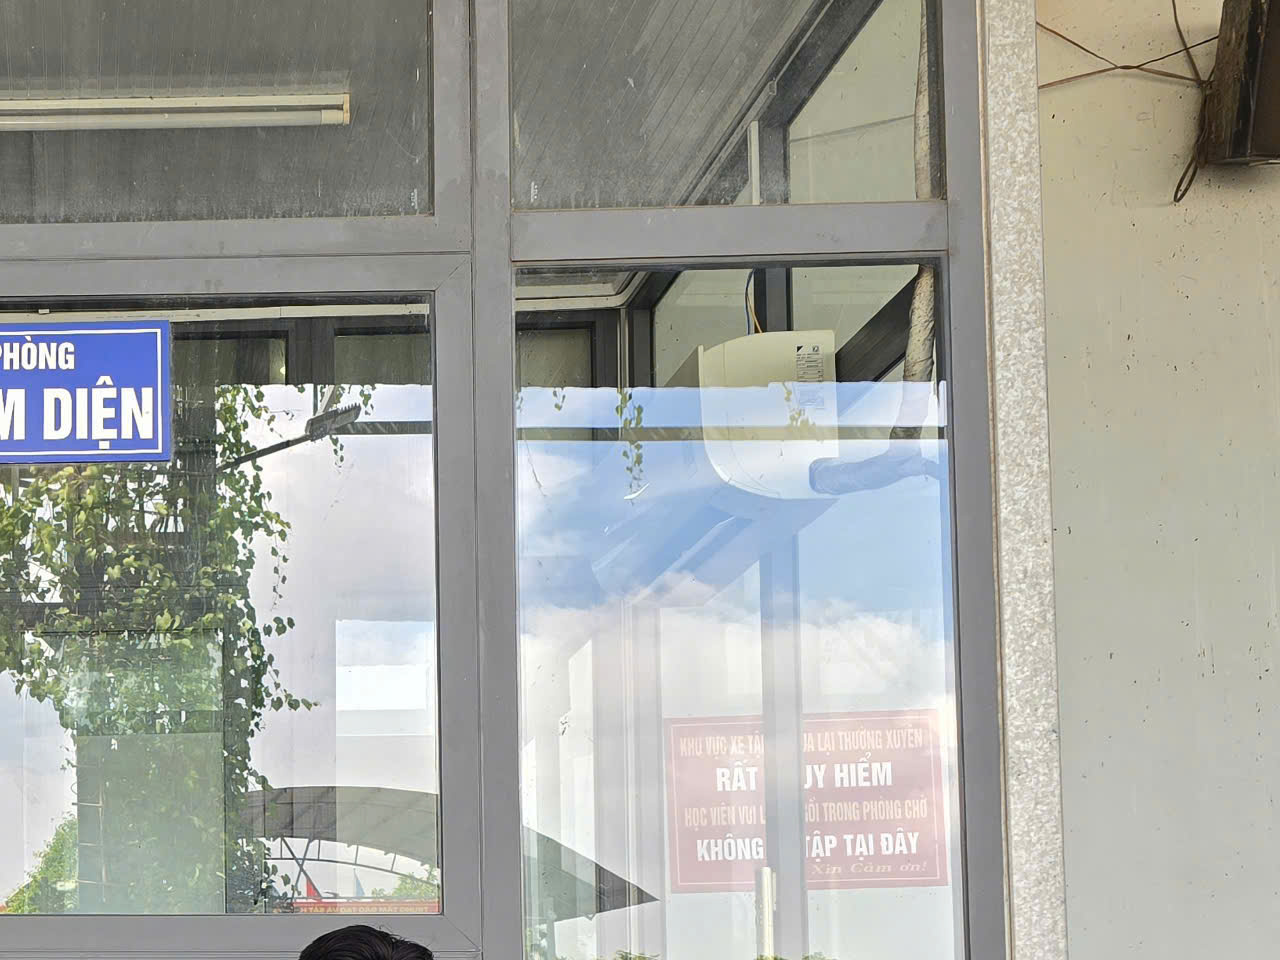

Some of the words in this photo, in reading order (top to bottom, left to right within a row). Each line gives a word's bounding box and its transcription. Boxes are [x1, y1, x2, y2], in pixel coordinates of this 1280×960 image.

[42, 375, 153, 449] DIỆN
[680, 736, 703, 757] KHU
[731, 735, 745, 754] XE
[818, 732, 835, 756] LẠI
[838, 726, 883, 751] THƯỜNG
[716, 760, 758, 792] RẤT
[804, 763, 825, 789] UY
[834, 752, 892, 788] HIỂM
[685, 807, 708, 831] HỌC
[710, 802, 736, 826] VIÊN
[823, 801, 860, 821] TRONG
[863, 795, 902, 820] PHÒNG
[904, 795, 928, 819] CHỜ
[696, 833, 764, 862] KHÔNG
[843, 833, 874, 861] TẠI
[880, 827, 919, 855] ĐÂY
[812, 862, 841, 875] Xin
